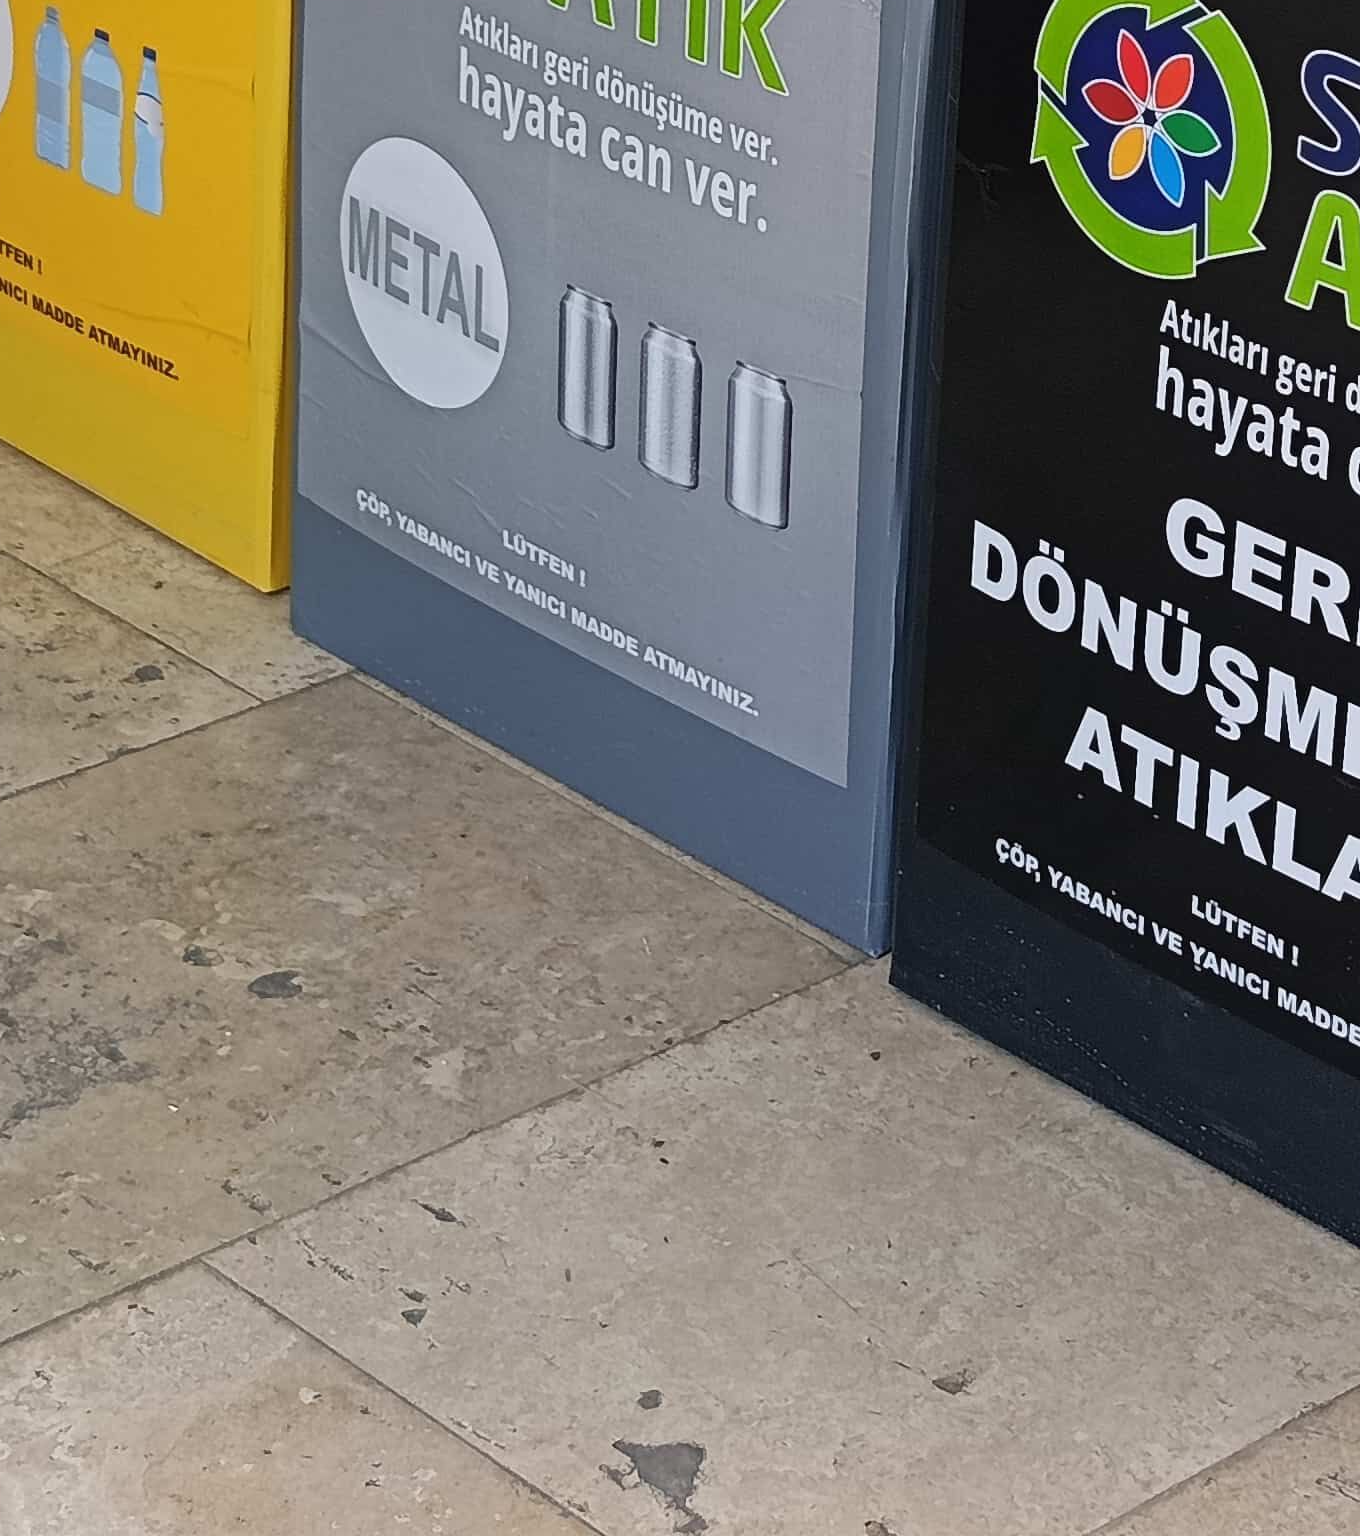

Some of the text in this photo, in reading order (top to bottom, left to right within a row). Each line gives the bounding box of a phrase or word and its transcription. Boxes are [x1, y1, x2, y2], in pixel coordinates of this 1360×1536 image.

[459, 46, 768, 232] hayata can ver.
[460, 6, 779, 165] Atıkları geri dönüşüme ver.
[32, 295, 84, 334] MADDE
[88, 323, 179, 380] ATMAYINIZ.
[348, 196, 500, 353] METAL
[1155, 345, 1329, 480] hayata
[1160, 299, 1268, 376] Atıkları
[1276, 353, 1336, 403] geri
[356, 488, 759, 718] ÇÖP, YABANCI VE YANICI MADDE ATMAYINIZ.
[502, 528, 575, 583] LÜTFEN
[995, 837, 1041, 882] ÇÖP,
[1047, 866, 1144, 936] YABANCI
[1152, 921, 1182, 956] VE
[1190, 942, 1269, 1001] YANICI
[1191, 894, 1284, 959] LÜTFEN
